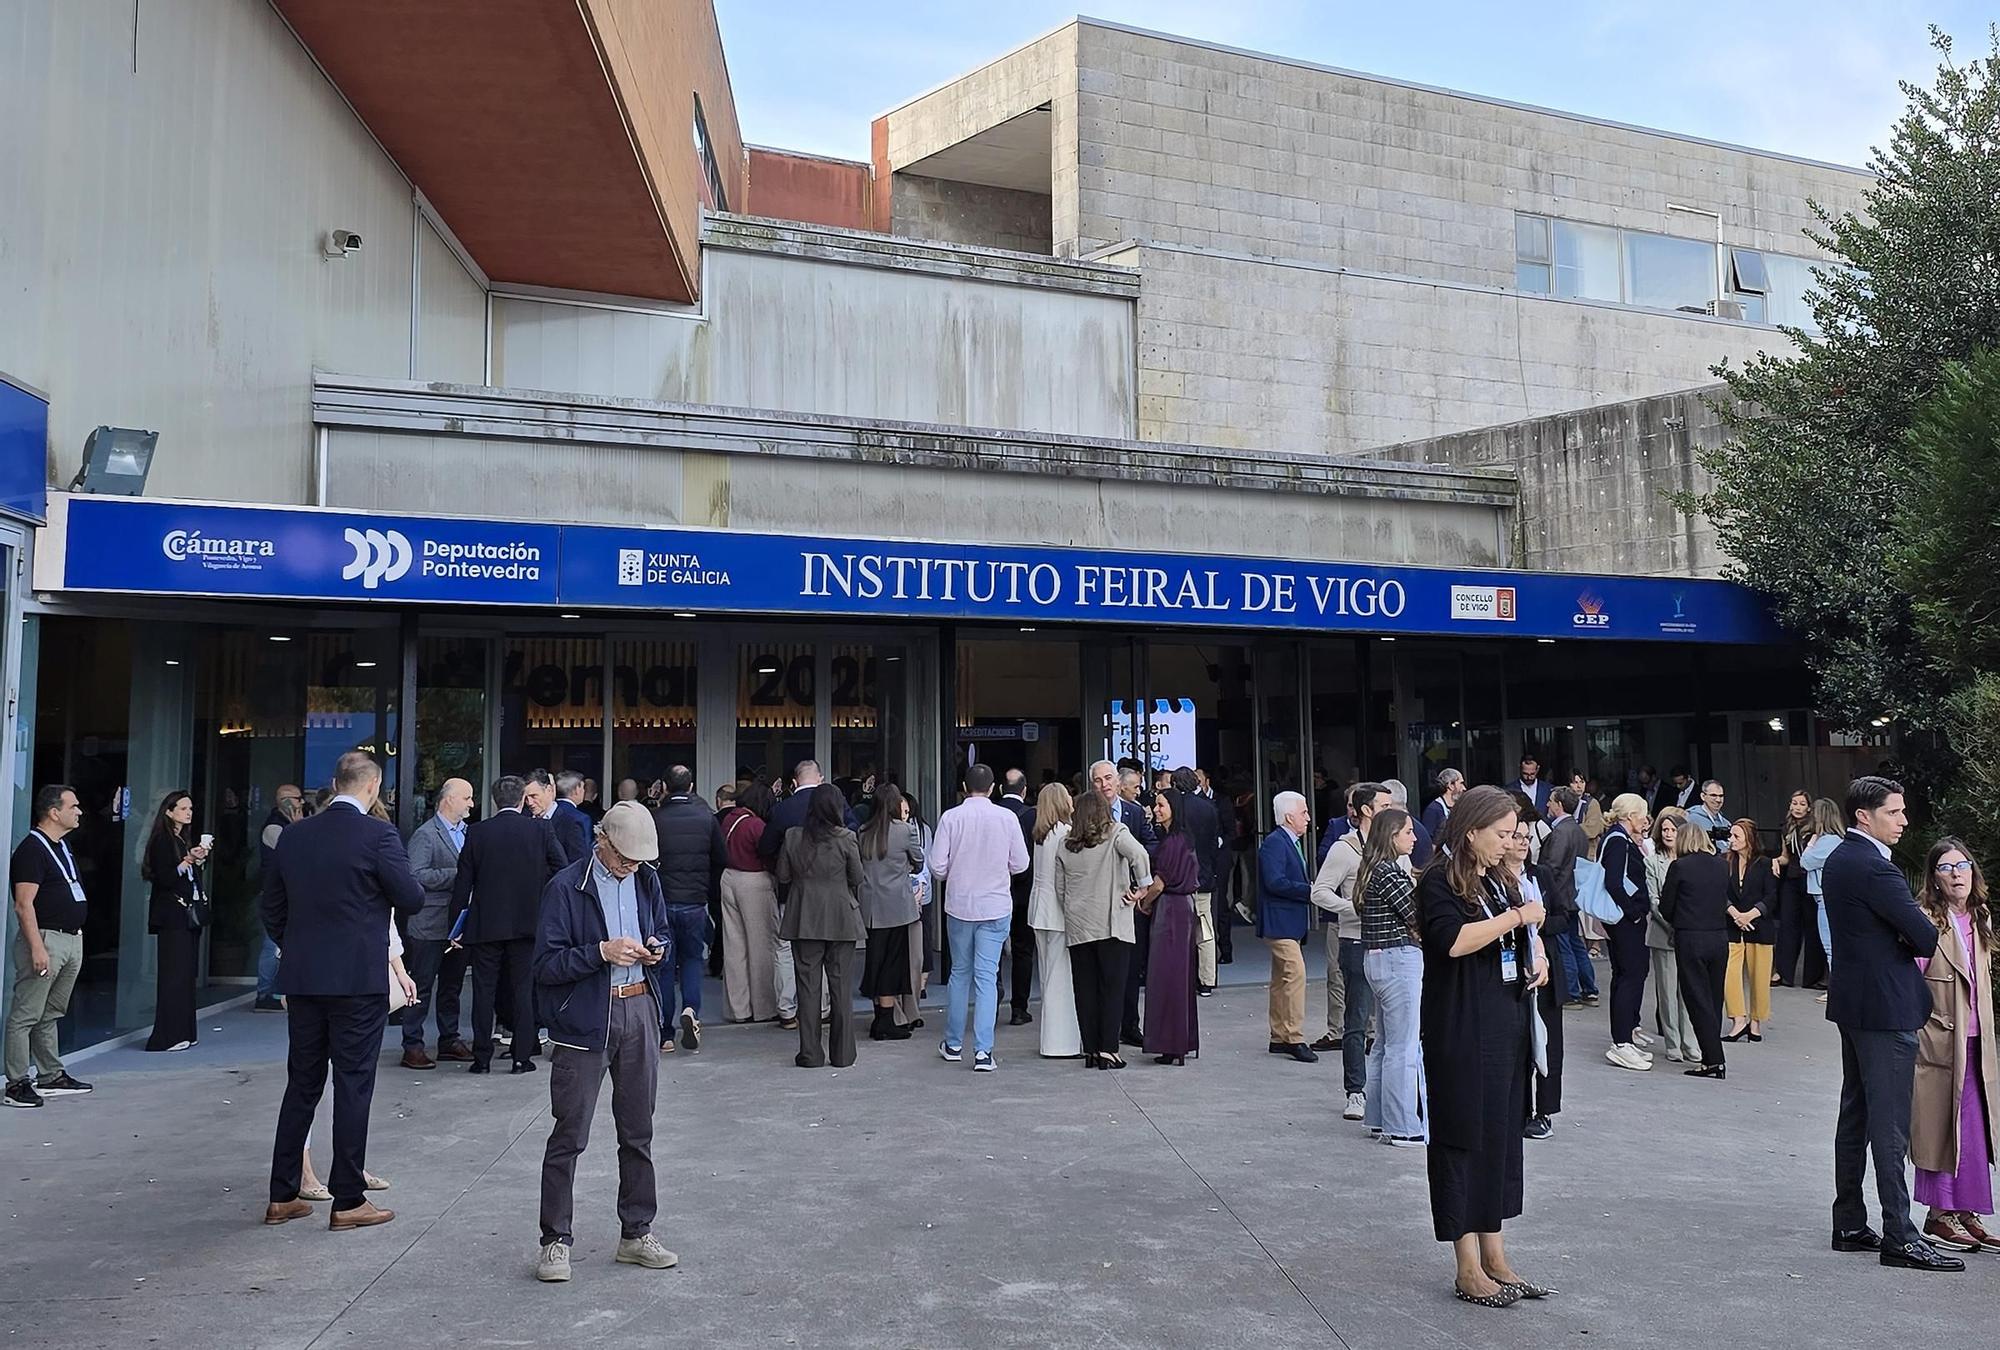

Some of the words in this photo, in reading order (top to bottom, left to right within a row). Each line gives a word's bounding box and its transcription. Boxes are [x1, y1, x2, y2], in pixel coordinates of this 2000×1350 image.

[423, 540, 540, 563] Deputación
[648, 553, 701, 569] XUNTA
[422, 560, 540, 580] Pontevedra
[647, 569, 668, 584] DE
[671, 570, 731, 586] GALICIA
[800, 552, 1062, 605] INSTITUTO
[1074, 565, 1231, 610] FEIRAL
[1241, 572, 1298, 613] DE
[1306, 576, 1406, 618] VIGO
[1455, 594, 1493, 603] CONCELLO
[1460, 603, 1470, 611] DE
[1471, 603, 1489, 612] VIGO
[1573, 613, 1609, 625] CEP
[1111, 721, 1170, 736] Frzen
[1120, 738, 1161, 753] food
